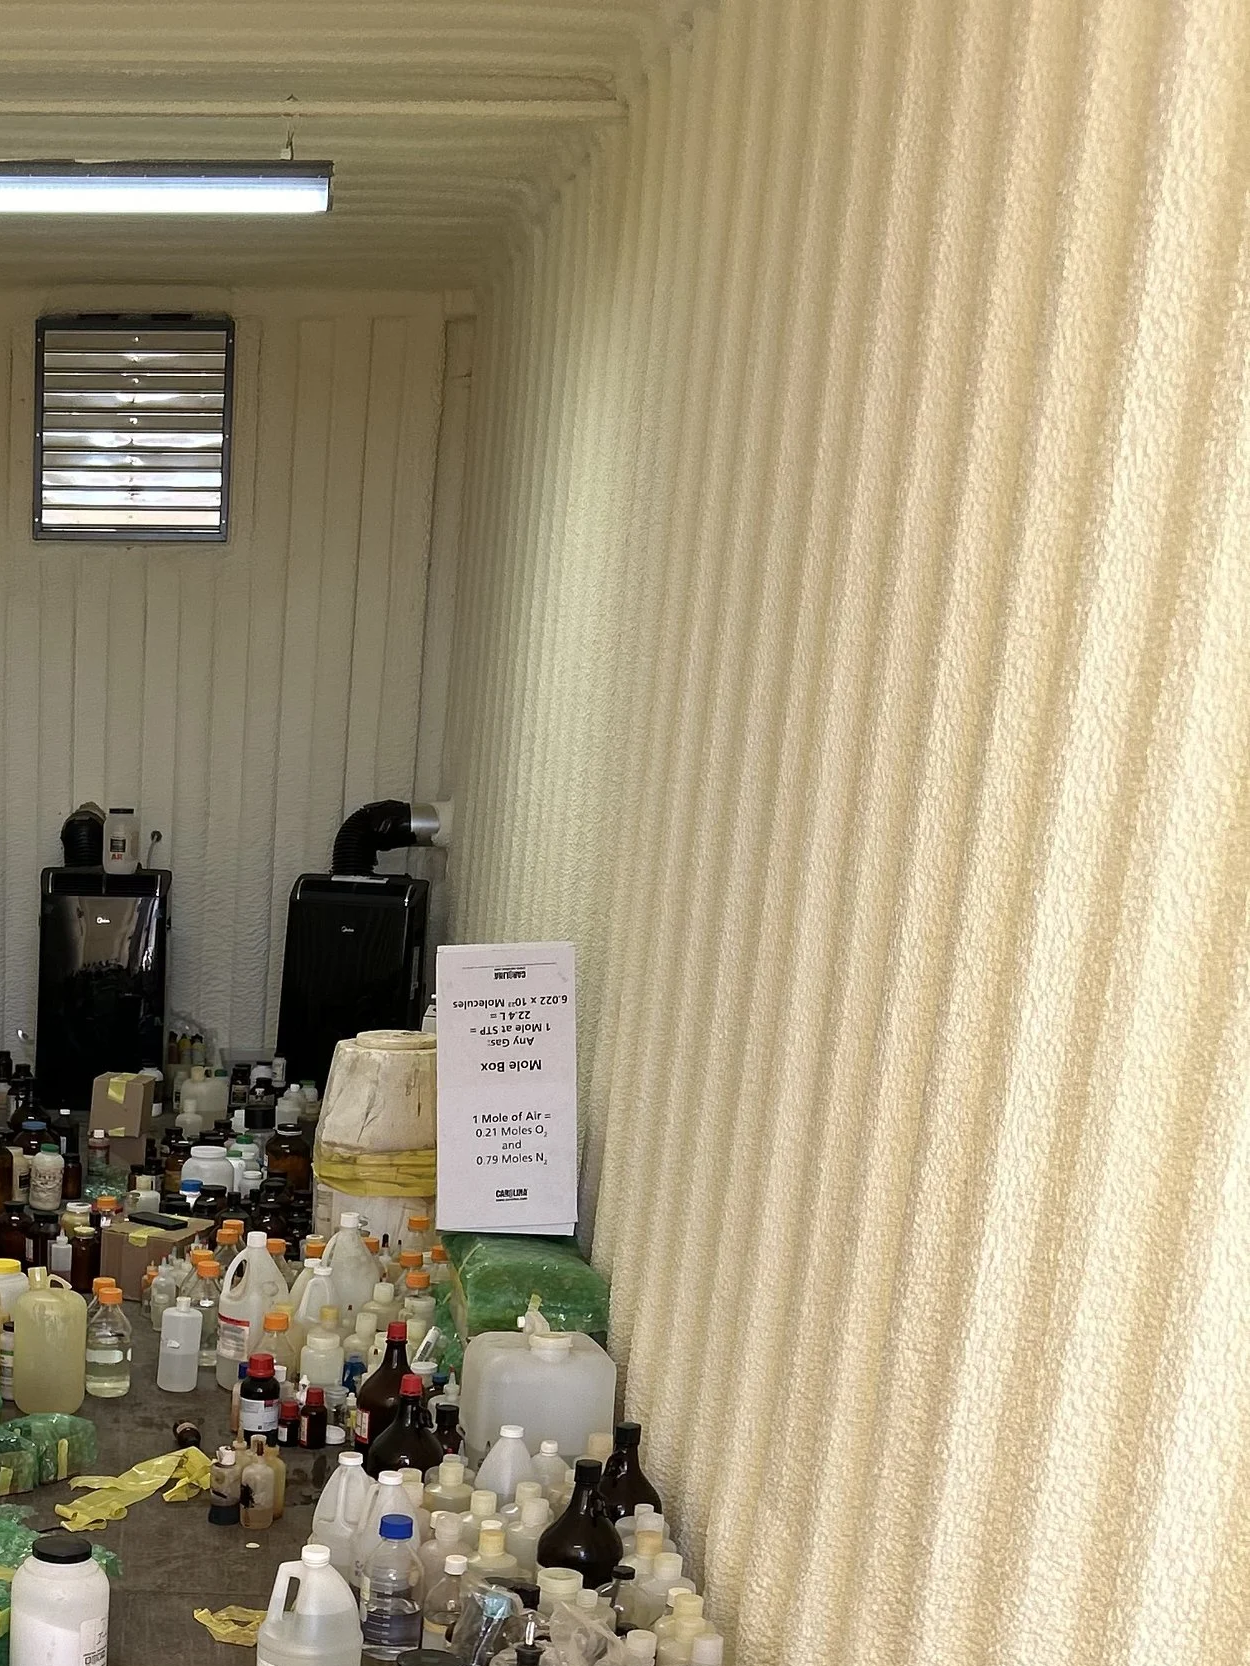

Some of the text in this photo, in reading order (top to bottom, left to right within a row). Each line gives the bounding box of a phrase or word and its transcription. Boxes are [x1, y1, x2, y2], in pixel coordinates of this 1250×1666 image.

[452, 998, 505, 1010] Molecules
[530, 996, 538, 1004] x
[539, 994, 568, 1006] 6.022
[499, 1012, 506, 1021] L
[508, 1010, 531, 1021] 22.4
[479, 1025, 499, 1036] STP
[514, 1022, 543, 1034] Mole
[545, 1023, 551, 1032] 1
[512, 1035, 535, 1046] Any
[480, 1059, 542, 1073] Mole Box
[472, 1115, 479, 1124] 1
[481, 1112, 509, 1124] Mole
[511, 1111, 523, 1122] of
[525, 1110, 542, 1121] Air
[475, 1127, 498, 1138] 0.21
[501, 1125, 533, 1137] Moles
[501, 1139, 522, 1150] and
[476, 1154, 499, 1166] 0.79
[501, 1153, 533, 1164] Moles
